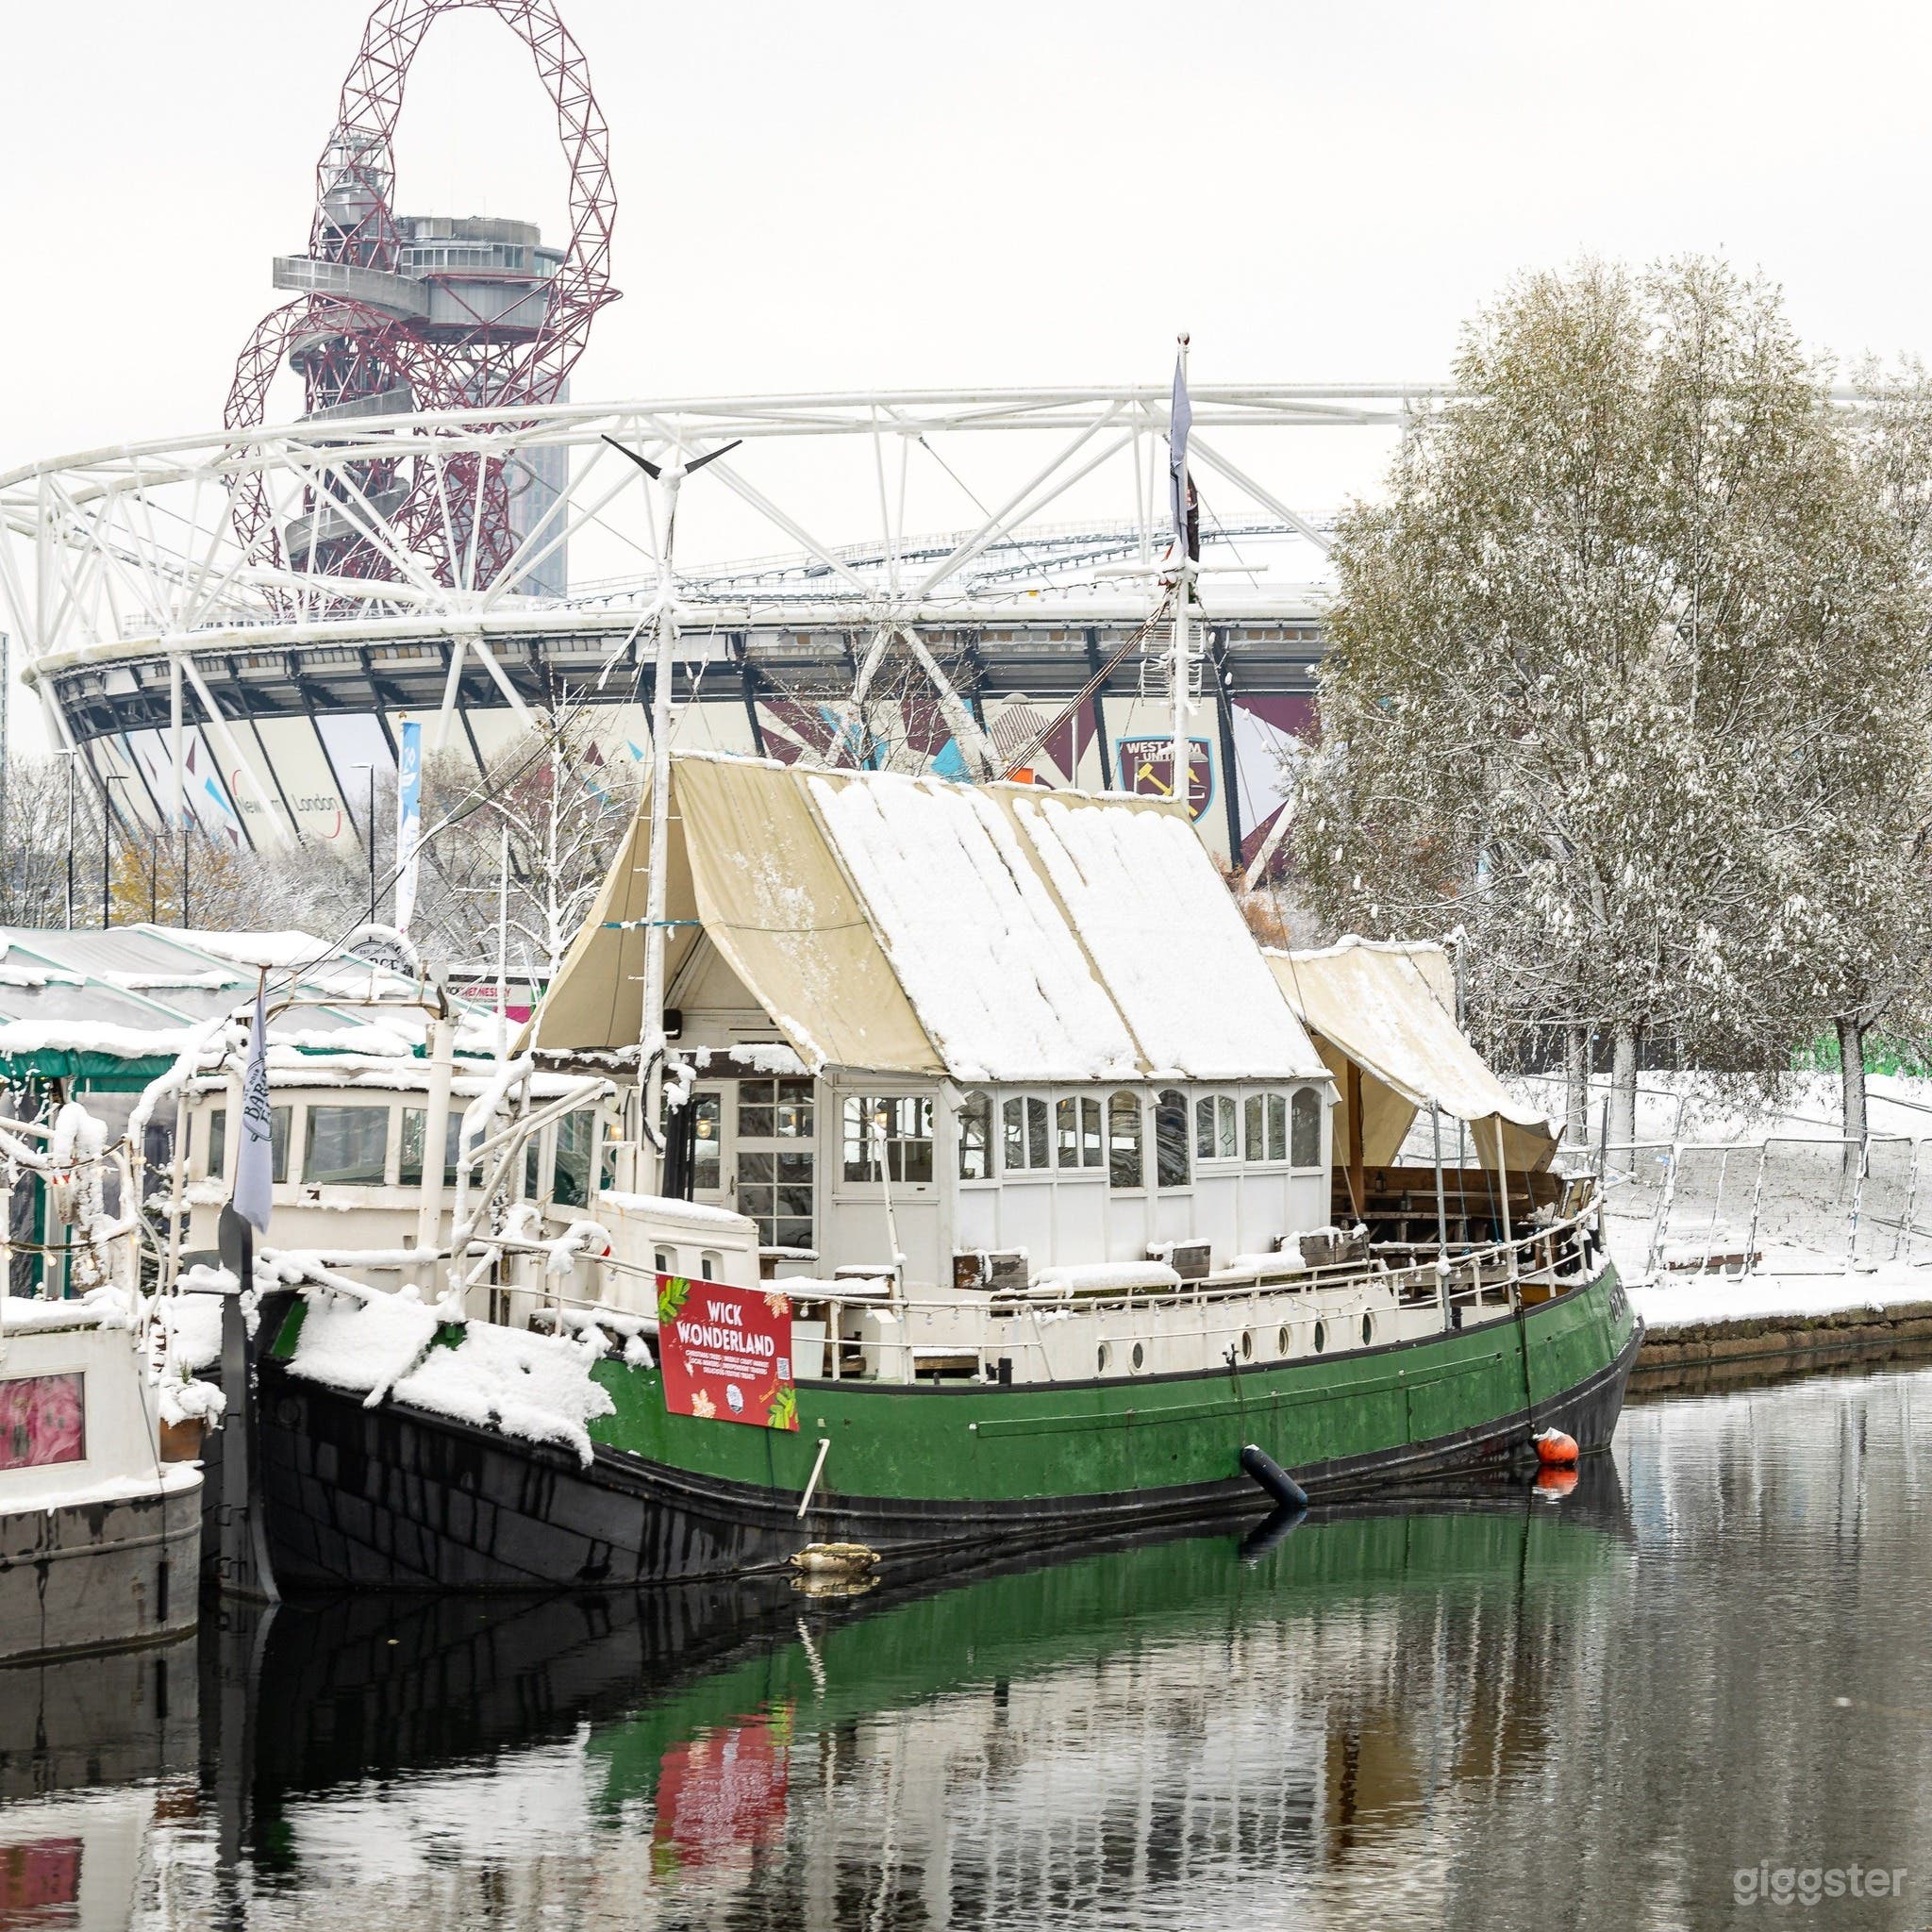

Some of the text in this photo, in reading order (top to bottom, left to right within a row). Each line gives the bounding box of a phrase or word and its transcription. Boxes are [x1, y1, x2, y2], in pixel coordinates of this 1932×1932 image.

[1126, 741, 1164, 754] WEST
[291, 793, 340, 812] London
[707, 1300, 743, 1326] WICK
[676, 1321, 775, 1357] WONDERLAND
